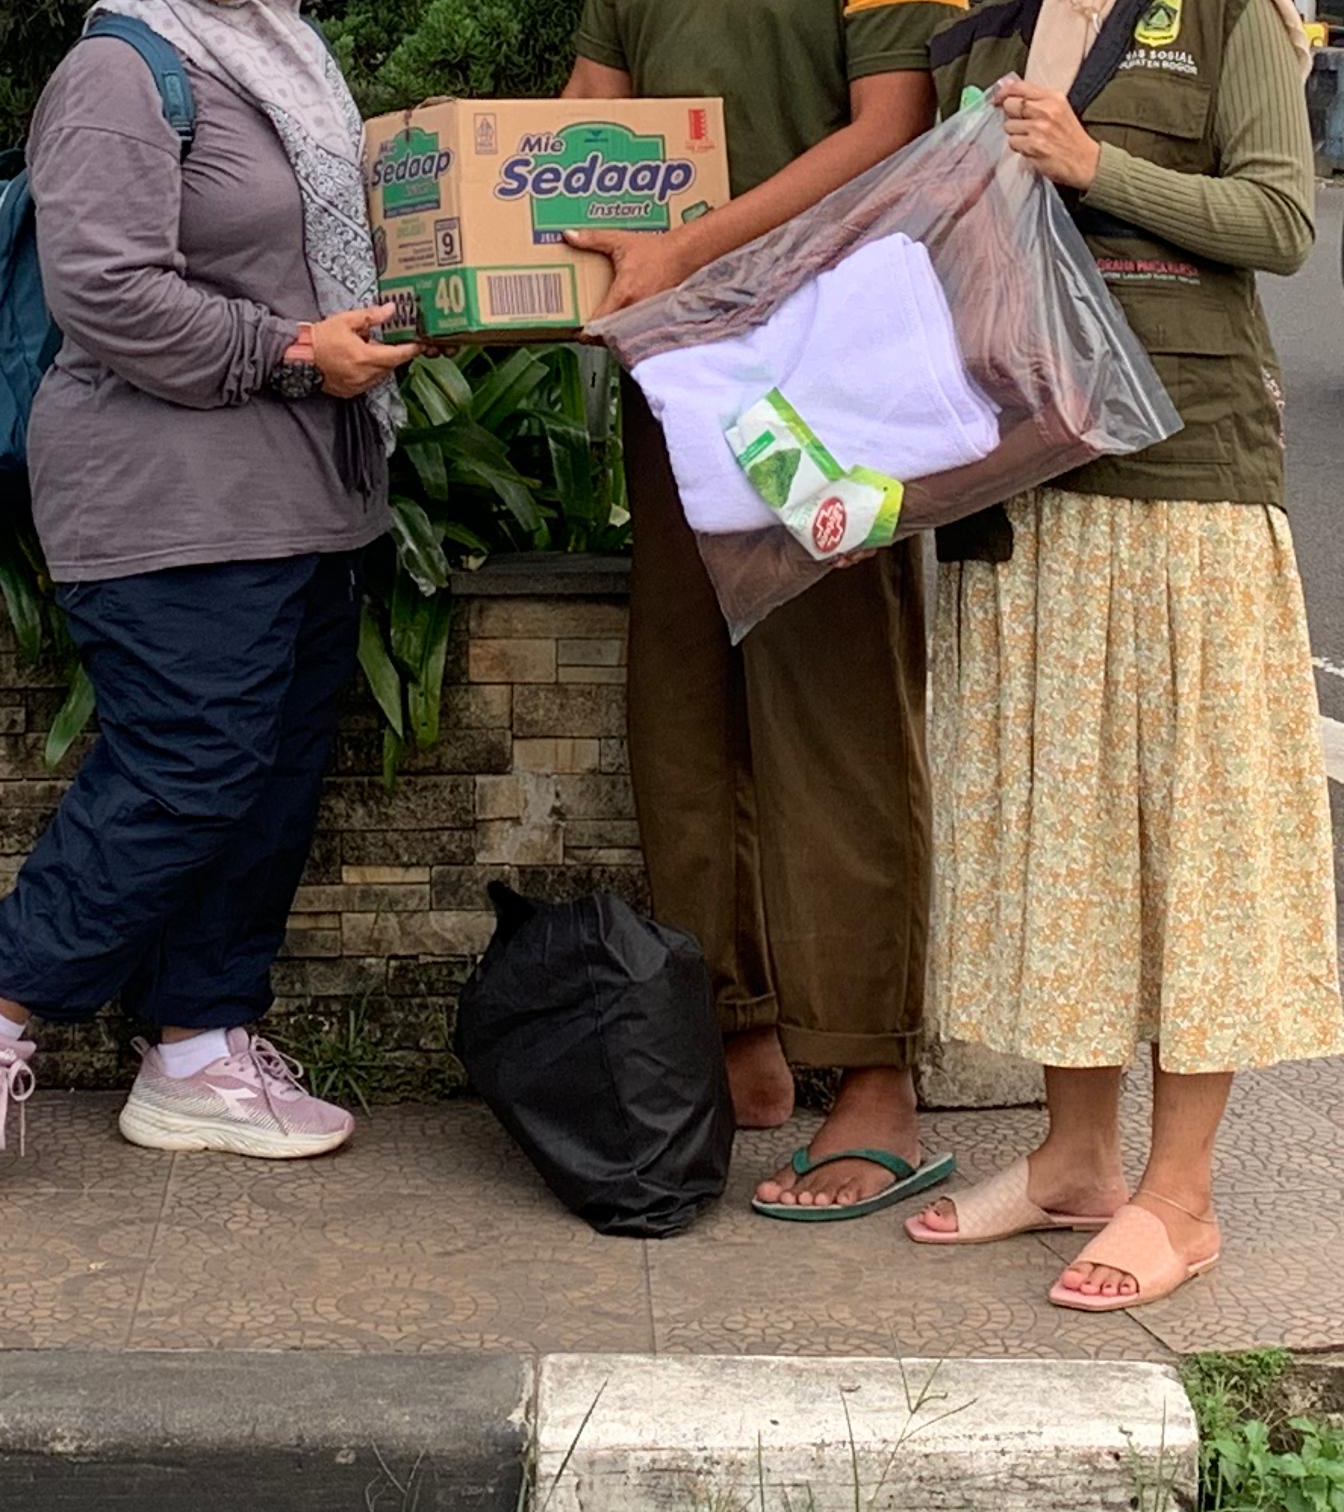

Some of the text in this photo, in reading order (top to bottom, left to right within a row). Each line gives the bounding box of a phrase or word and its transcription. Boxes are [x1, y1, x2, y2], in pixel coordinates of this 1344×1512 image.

[1149, 49, 1195, 65] SOSIAL
[1161, 60, 1198, 76] BOGOR
[520, 134, 564, 153] Mie
[371, 149, 452, 187] Sedaap
[497, 153, 693, 200] Sedaap
[588, 201, 651, 218] Instant
[442, 231, 454, 255] 9
[435, 274, 465, 315] 40
